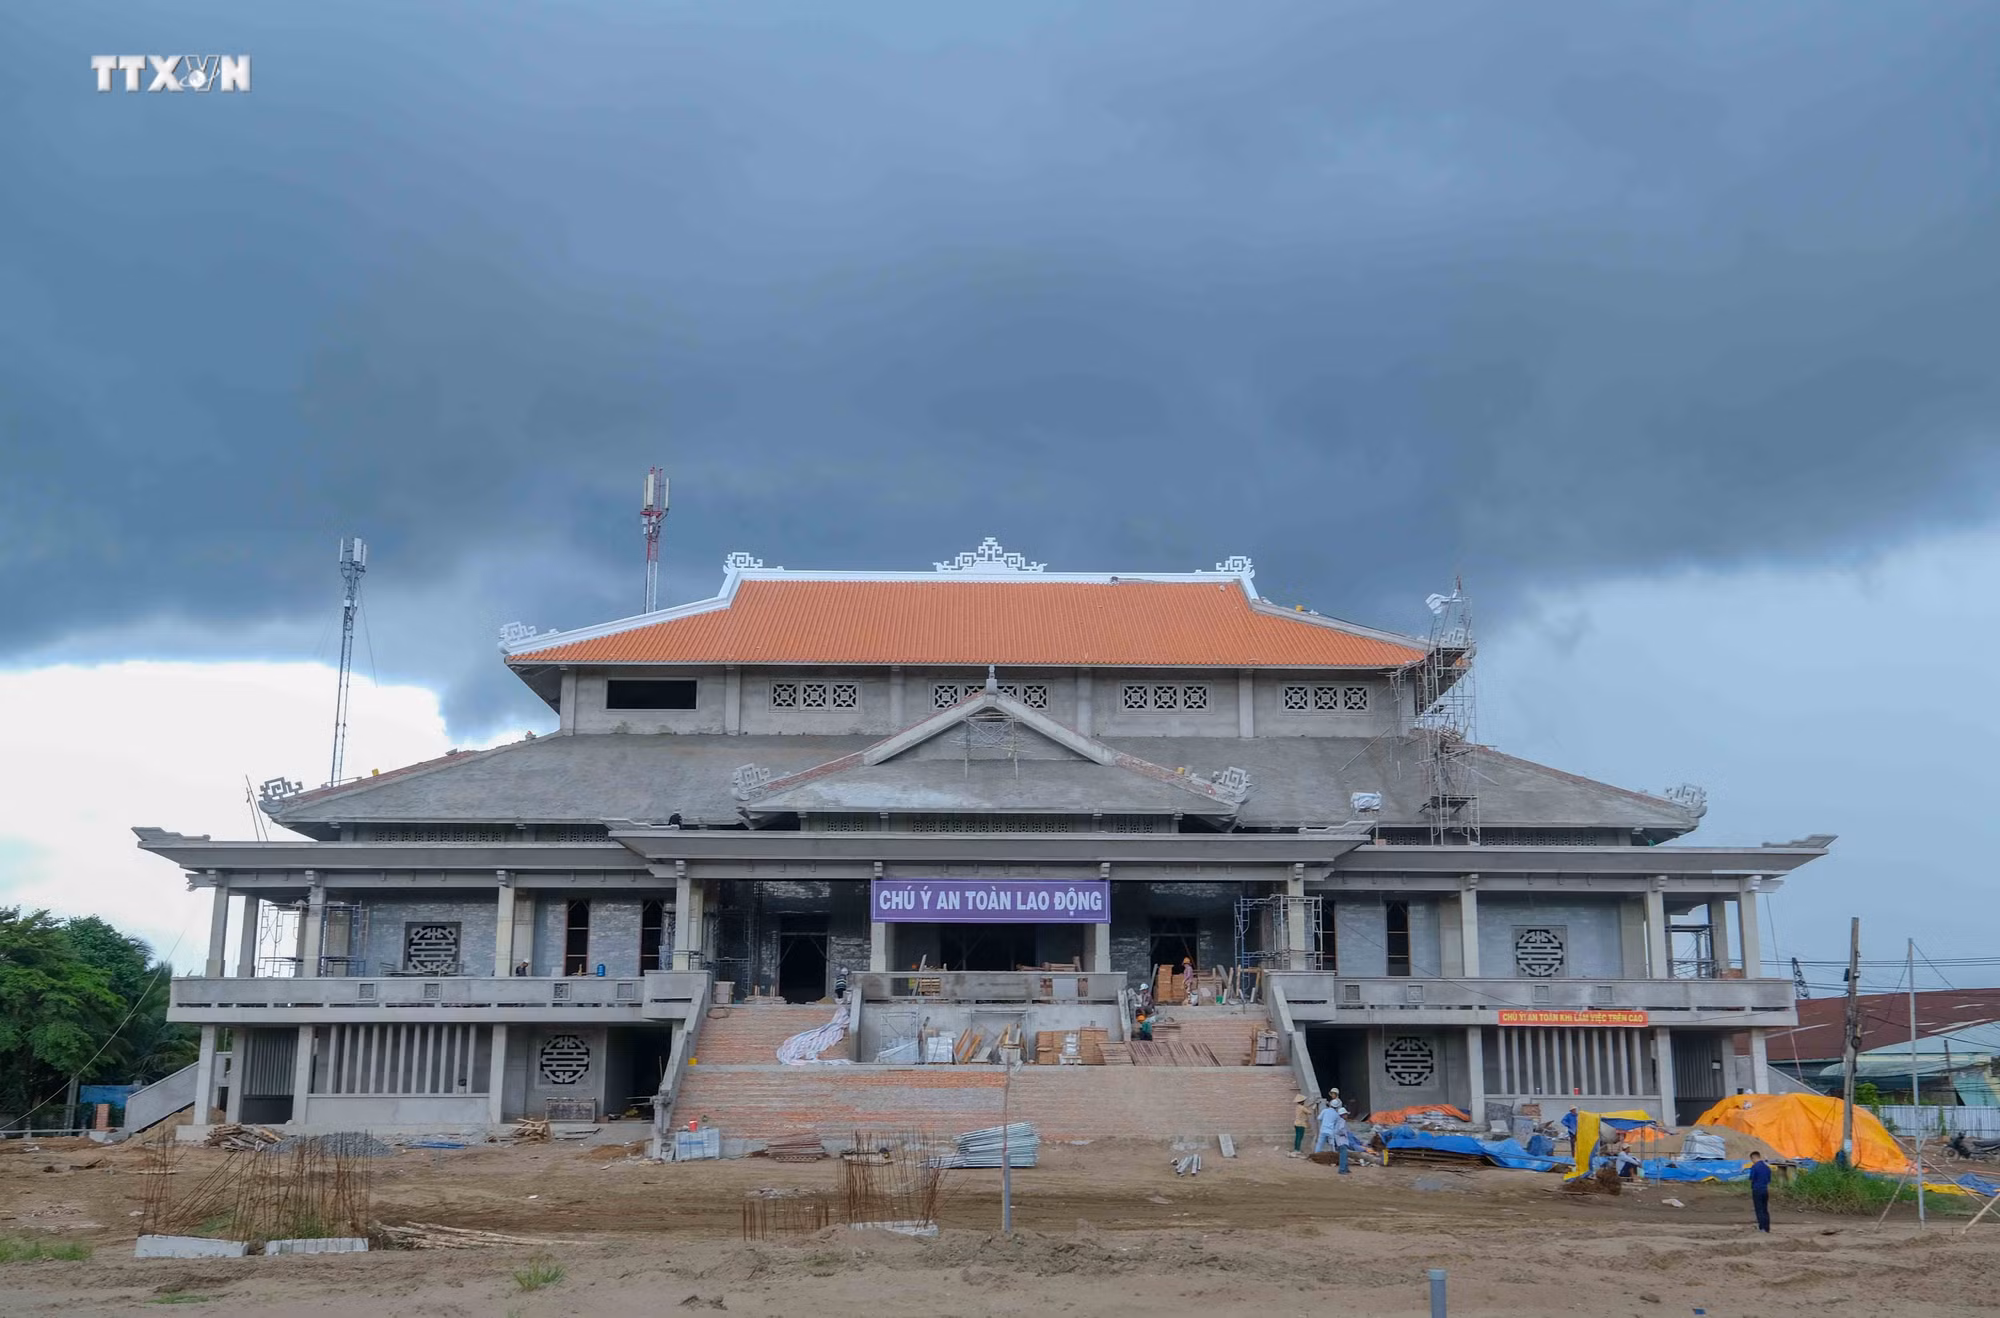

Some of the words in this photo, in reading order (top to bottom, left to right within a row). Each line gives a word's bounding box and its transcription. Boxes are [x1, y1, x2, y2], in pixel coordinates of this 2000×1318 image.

[879, 885, 915, 911] CHÚ
[919, 885, 932, 910] Ý
[936, 891, 960, 910] AN
[965, 885, 1012, 911] TOÀN
[1016, 890, 1050, 911] LAO
[1053, 886, 1103, 917] ĐỘNG
[1503, 1011, 1518, 1022] CHÚ
[1527, 1013, 1538, 1022] AN
[1539, 1011, 1559, 1022] TOÀN
[1628, 1013, 1644, 1023] CAO
